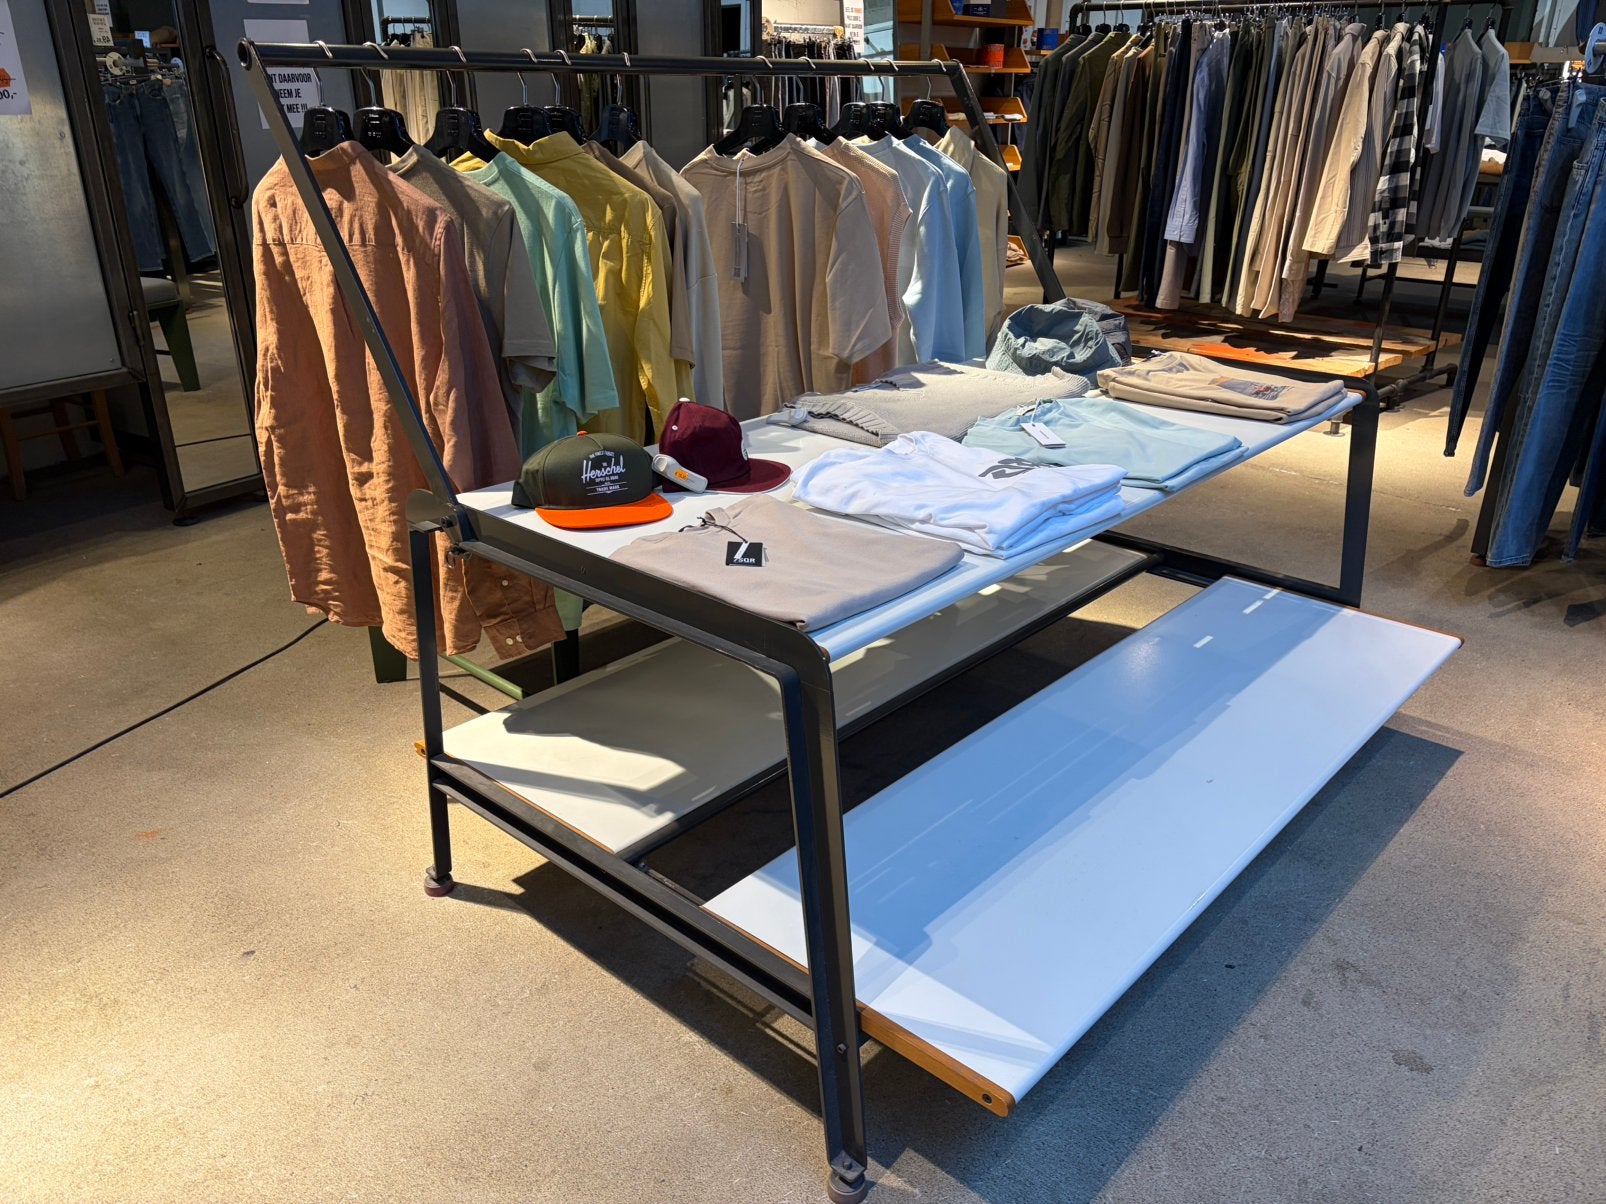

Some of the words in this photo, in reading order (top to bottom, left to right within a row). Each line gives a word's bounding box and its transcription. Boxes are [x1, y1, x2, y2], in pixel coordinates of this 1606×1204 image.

[278, 72, 312, 83] DAARVOOR
[278, 88, 293, 98] EEM
[294, 88, 302, 98] JE
[286, 103, 300, 113] MEE
[581, 455, 626, 484] Herschel
